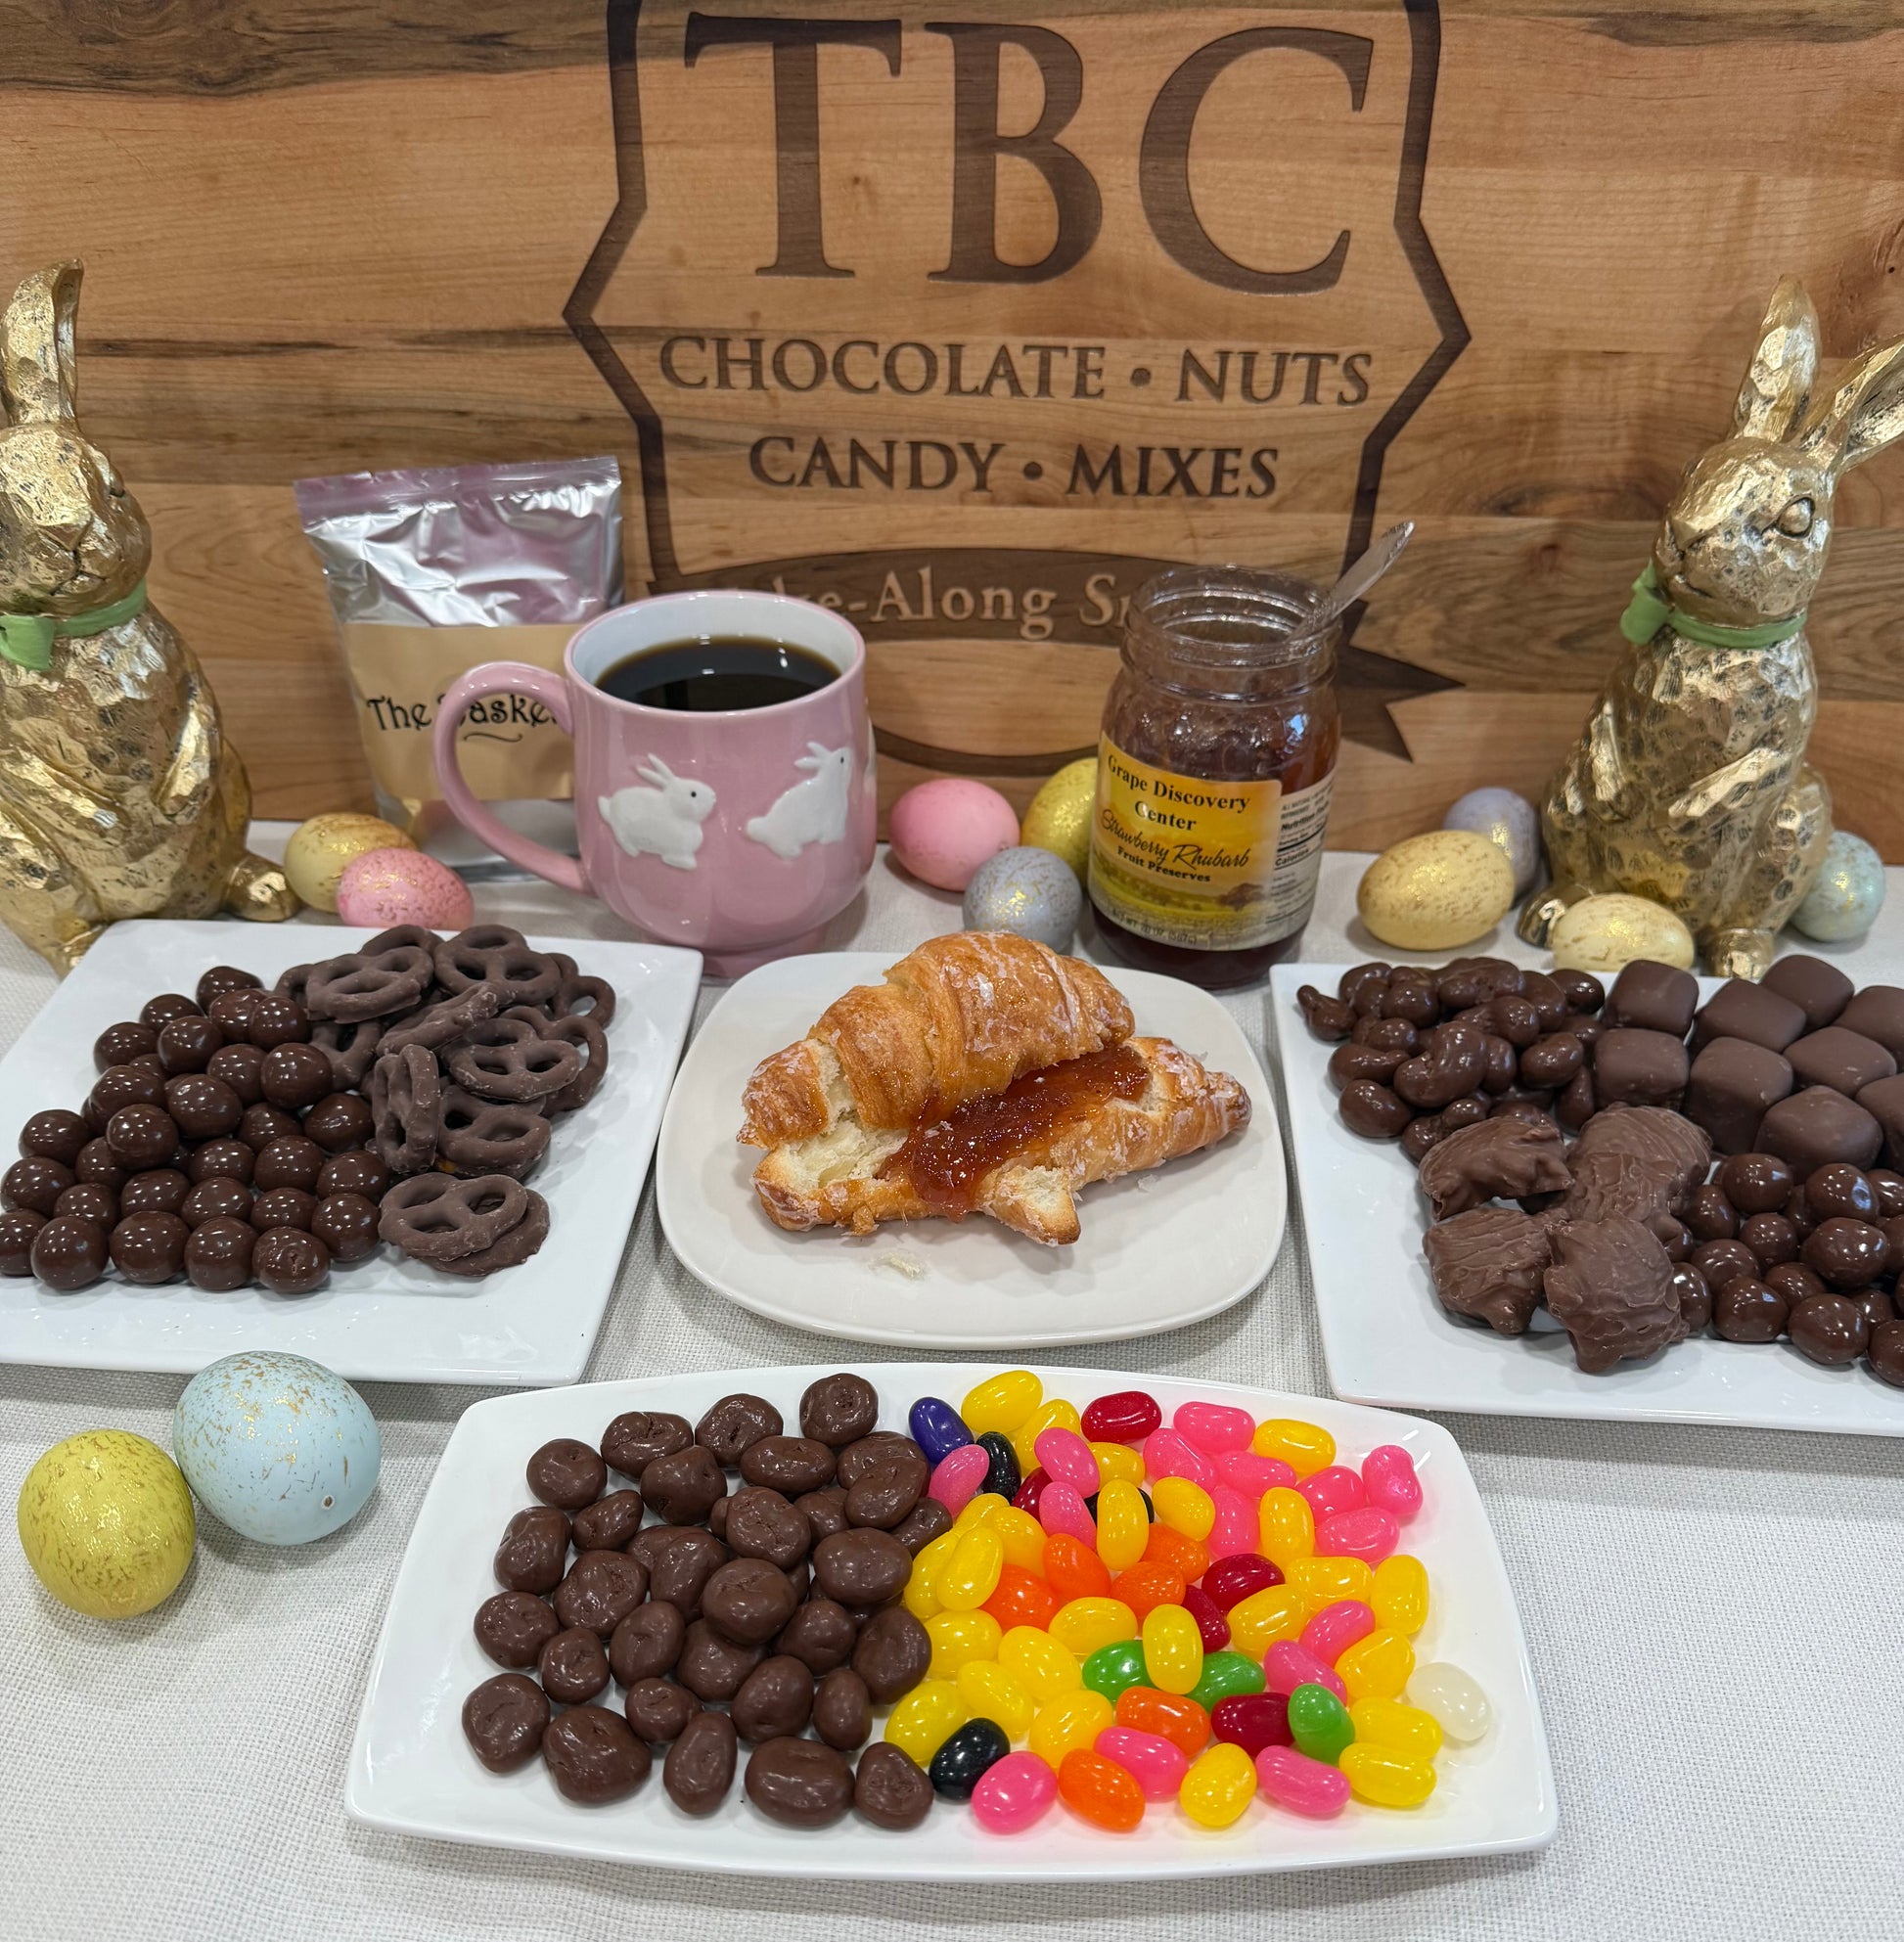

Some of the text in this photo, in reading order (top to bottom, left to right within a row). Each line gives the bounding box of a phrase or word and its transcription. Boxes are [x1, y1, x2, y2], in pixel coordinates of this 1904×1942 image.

[684, 11, 1374, 296] TBC
[658, 336, 1374, 408] CHOCOLATE NUTS
[748, 435, 1279, 499] CANDY MIXES
[367, 694, 557, 731] The aske
[1108, 754, 1148, 791] Grape
[1154, 781, 1249, 814] Discovery
[1101, 809, 1250, 871] Strawberry Rhubarb
[1135, 800, 1197, 831] Center
[1116, 846, 1211, 882] Fruit Preserves
[1275, 848, 1309, 867] Calories
